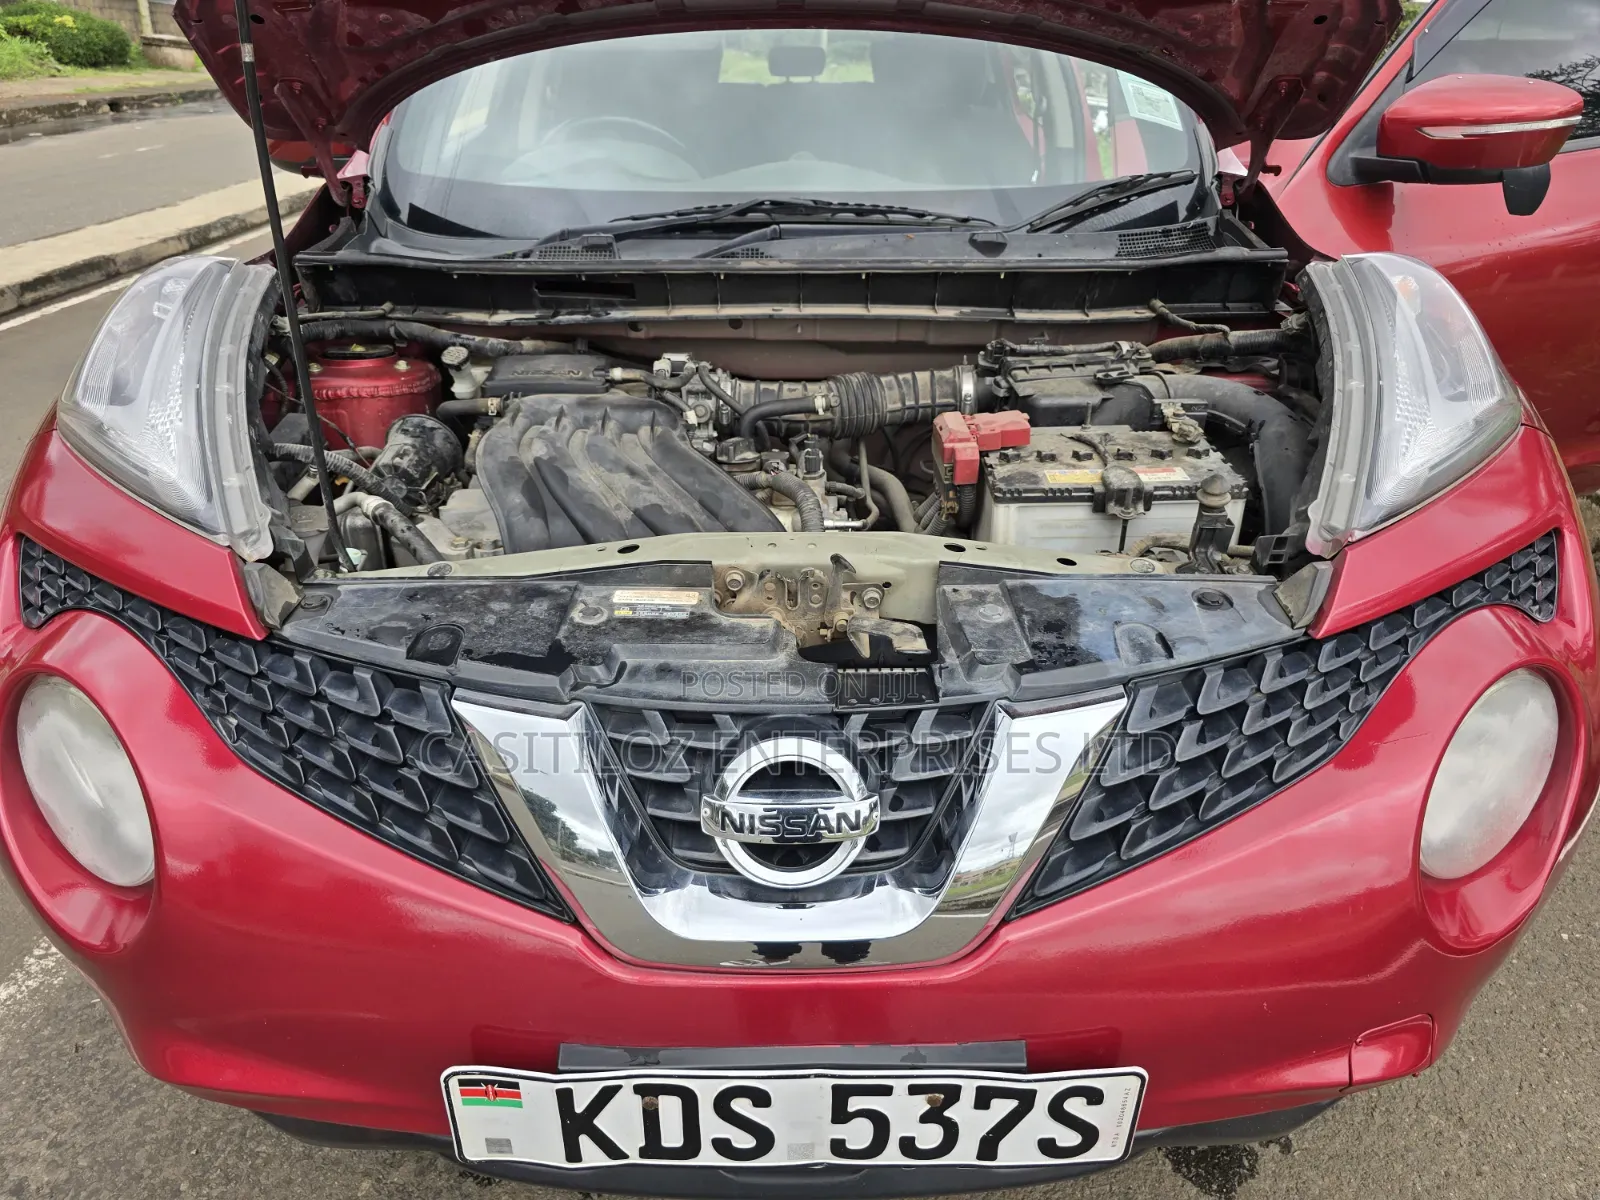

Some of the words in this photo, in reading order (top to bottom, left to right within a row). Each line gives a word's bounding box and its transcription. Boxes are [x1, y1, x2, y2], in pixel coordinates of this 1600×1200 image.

[719, 808, 862, 838] NISSAN
[556, 1084, 775, 1162] KDS
[831, 1084, 1105, 1161] 537S
